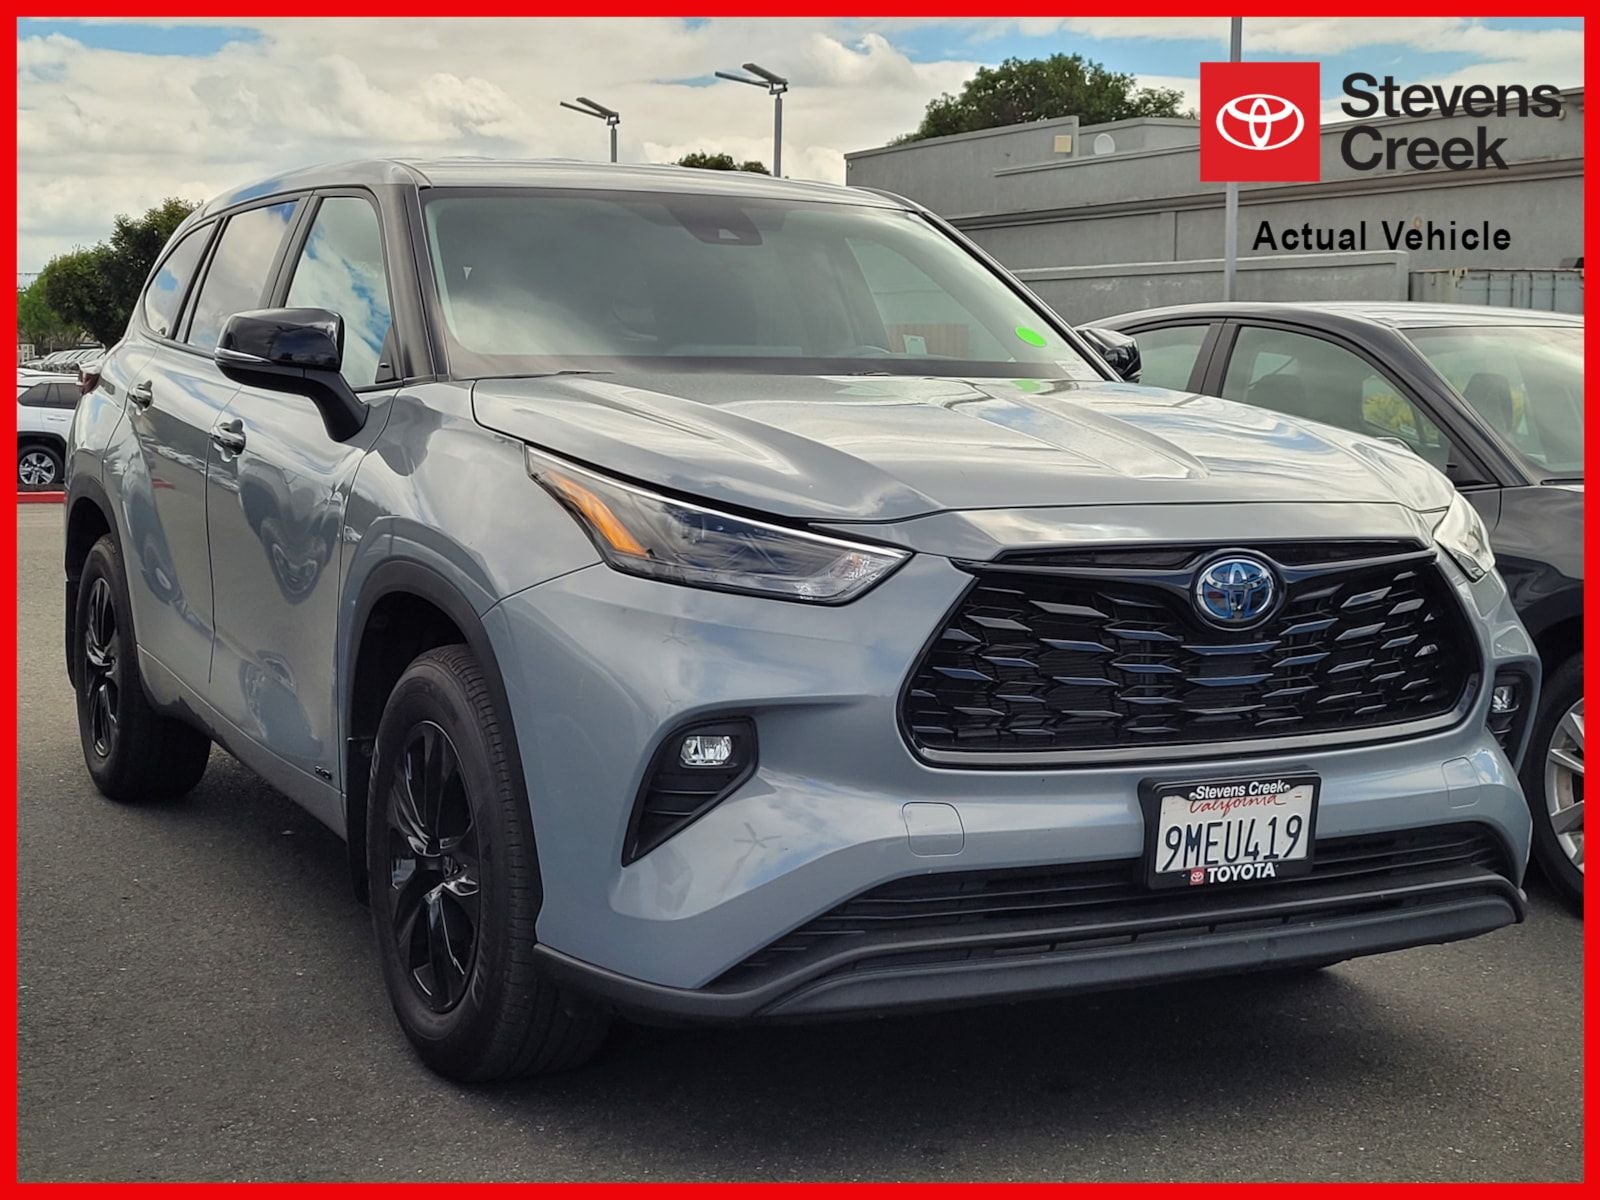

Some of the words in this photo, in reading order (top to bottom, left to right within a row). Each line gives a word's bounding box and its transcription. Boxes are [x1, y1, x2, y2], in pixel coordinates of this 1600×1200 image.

[1195, 785, 1245, 800] Stevens
[1249, 779, 1284, 795] Creek
[1162, 815, 1303, 871] 9MEU419
[1208, 862, 1276, 884] TOYOTA
